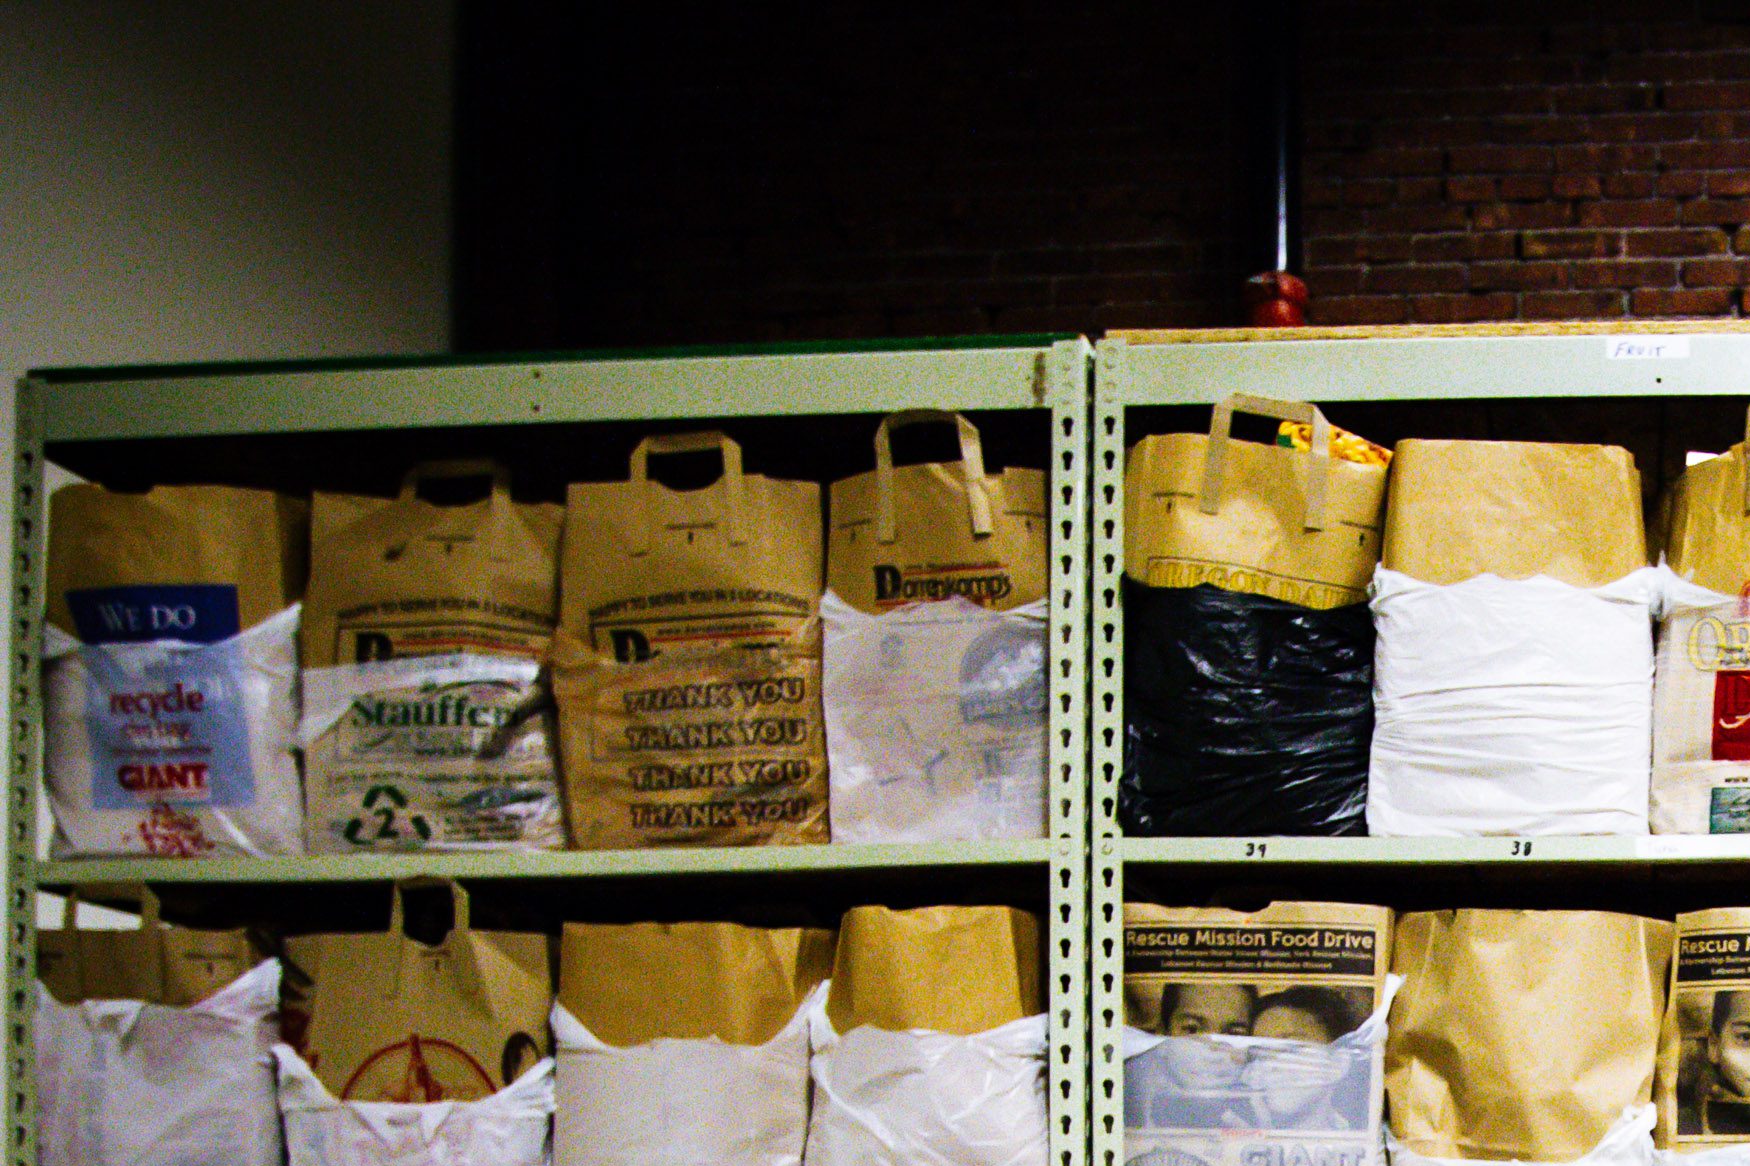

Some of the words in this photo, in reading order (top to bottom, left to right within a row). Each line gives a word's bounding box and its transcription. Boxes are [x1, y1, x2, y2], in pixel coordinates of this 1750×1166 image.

[1614, 342, 1666, 357] FRUIT
[100, 603, 141, 632] WE
[152, 604, 196, 631] DO
[109, 682, 204, 721] recycle
[624, 686, 733, 714] THANK
[737, 677, 805, 706] YOU
[624, 722, 733, 748] THANK
[738, 718, 806, 745] YOU
[117, 763, 209, 791] GIANT
[629, 761, 734, 791] THANK
[737, 759, 811, 783] YOU
[374, 806, 399, 839] 2
[630, 802, 736, 828] THANK
[743, 796, 815, 822] YOU
[1246, 842, 1267, 858] 39
[1511, 841, 1533, 857] 38
[1126, 931, 1189, 947] Rescue
[1195, 931, 1266, 946] Mission
[1271, 931, 1318, 947] Food
[1324, 932, 1373, 949] Drive
[1681, 938, 1739, 954] Rescue
